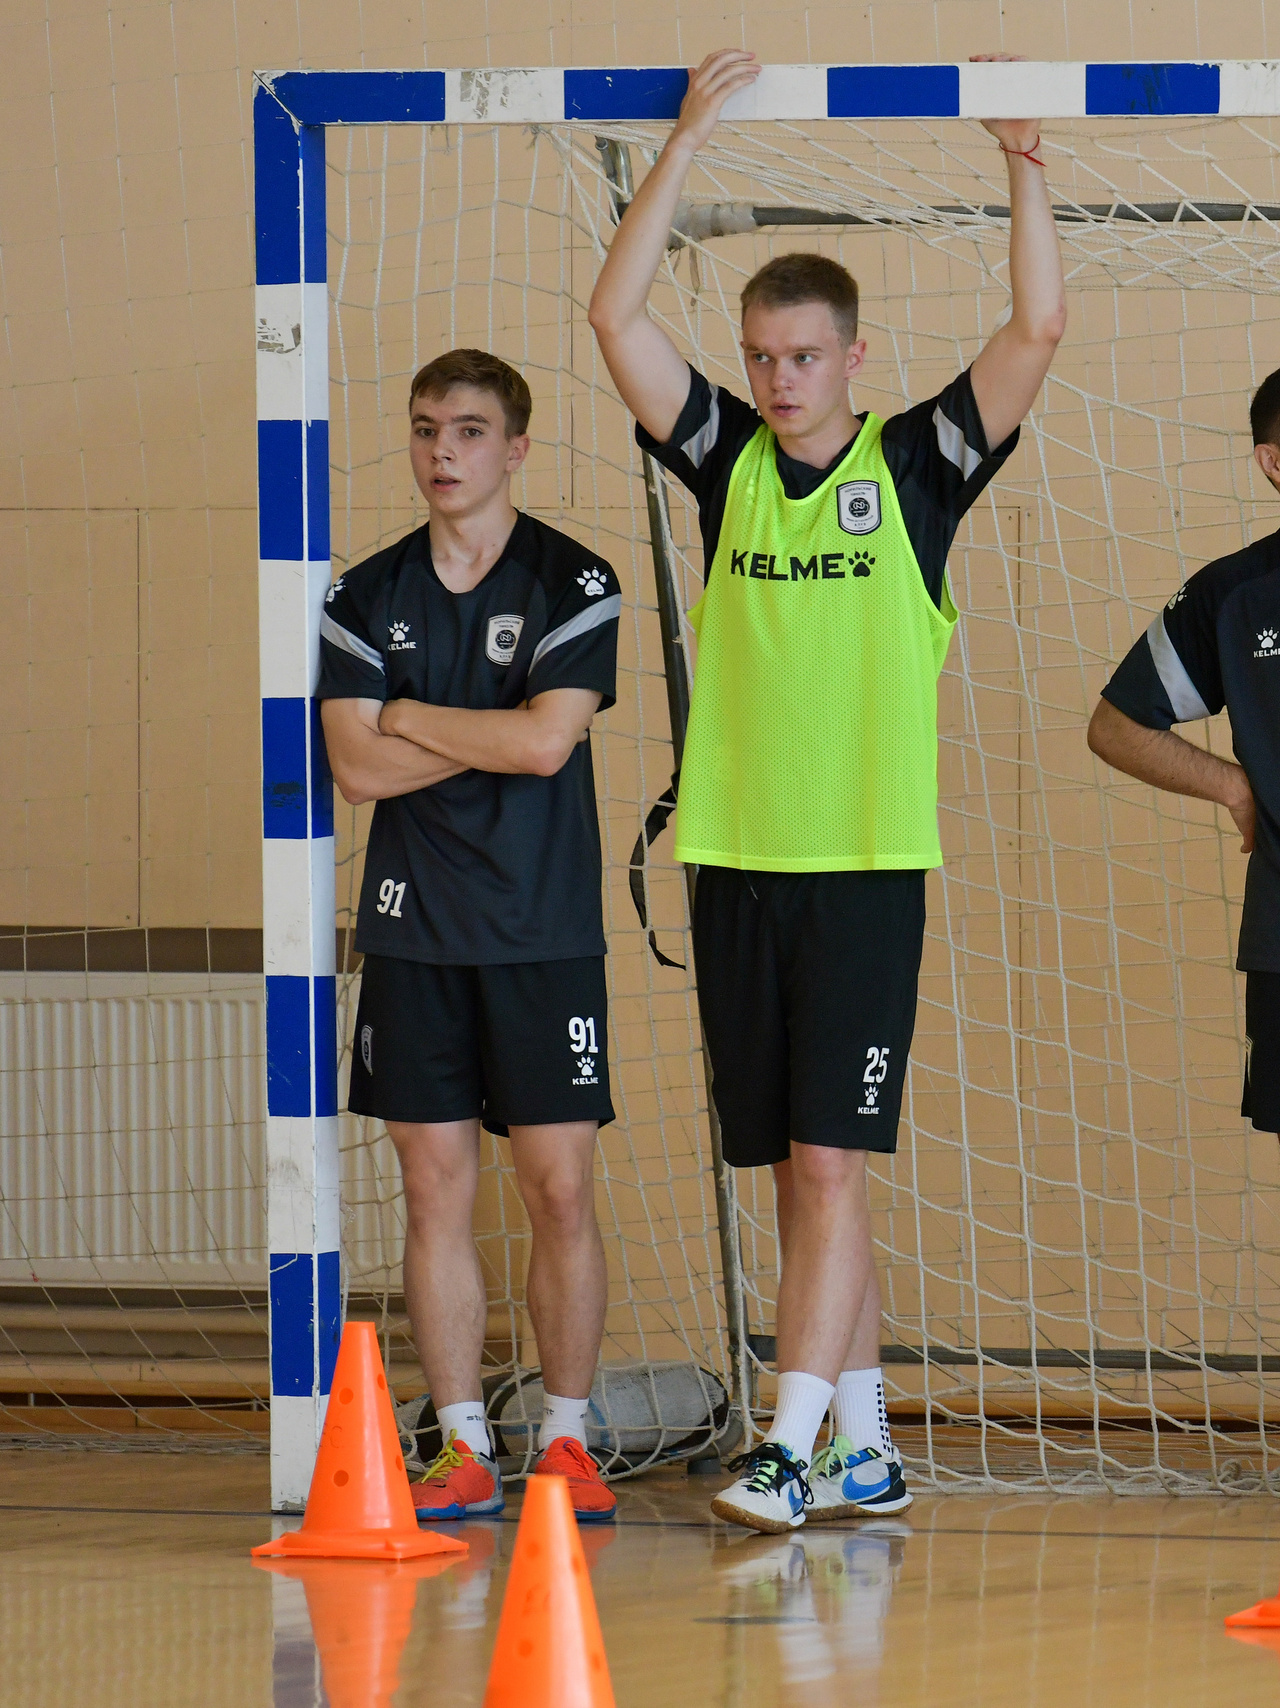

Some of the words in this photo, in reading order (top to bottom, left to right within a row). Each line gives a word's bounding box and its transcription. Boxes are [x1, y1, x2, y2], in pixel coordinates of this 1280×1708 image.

[731, 549, 846, 581] KELME
[376, 878, 407, 918] 91
[568, 1016, 599, 1053] 91
[572, 1076, 599, 1086] KELME
[862, 1046, 890, 1084] 25
[857, 1106, 880, 1115] KELME
